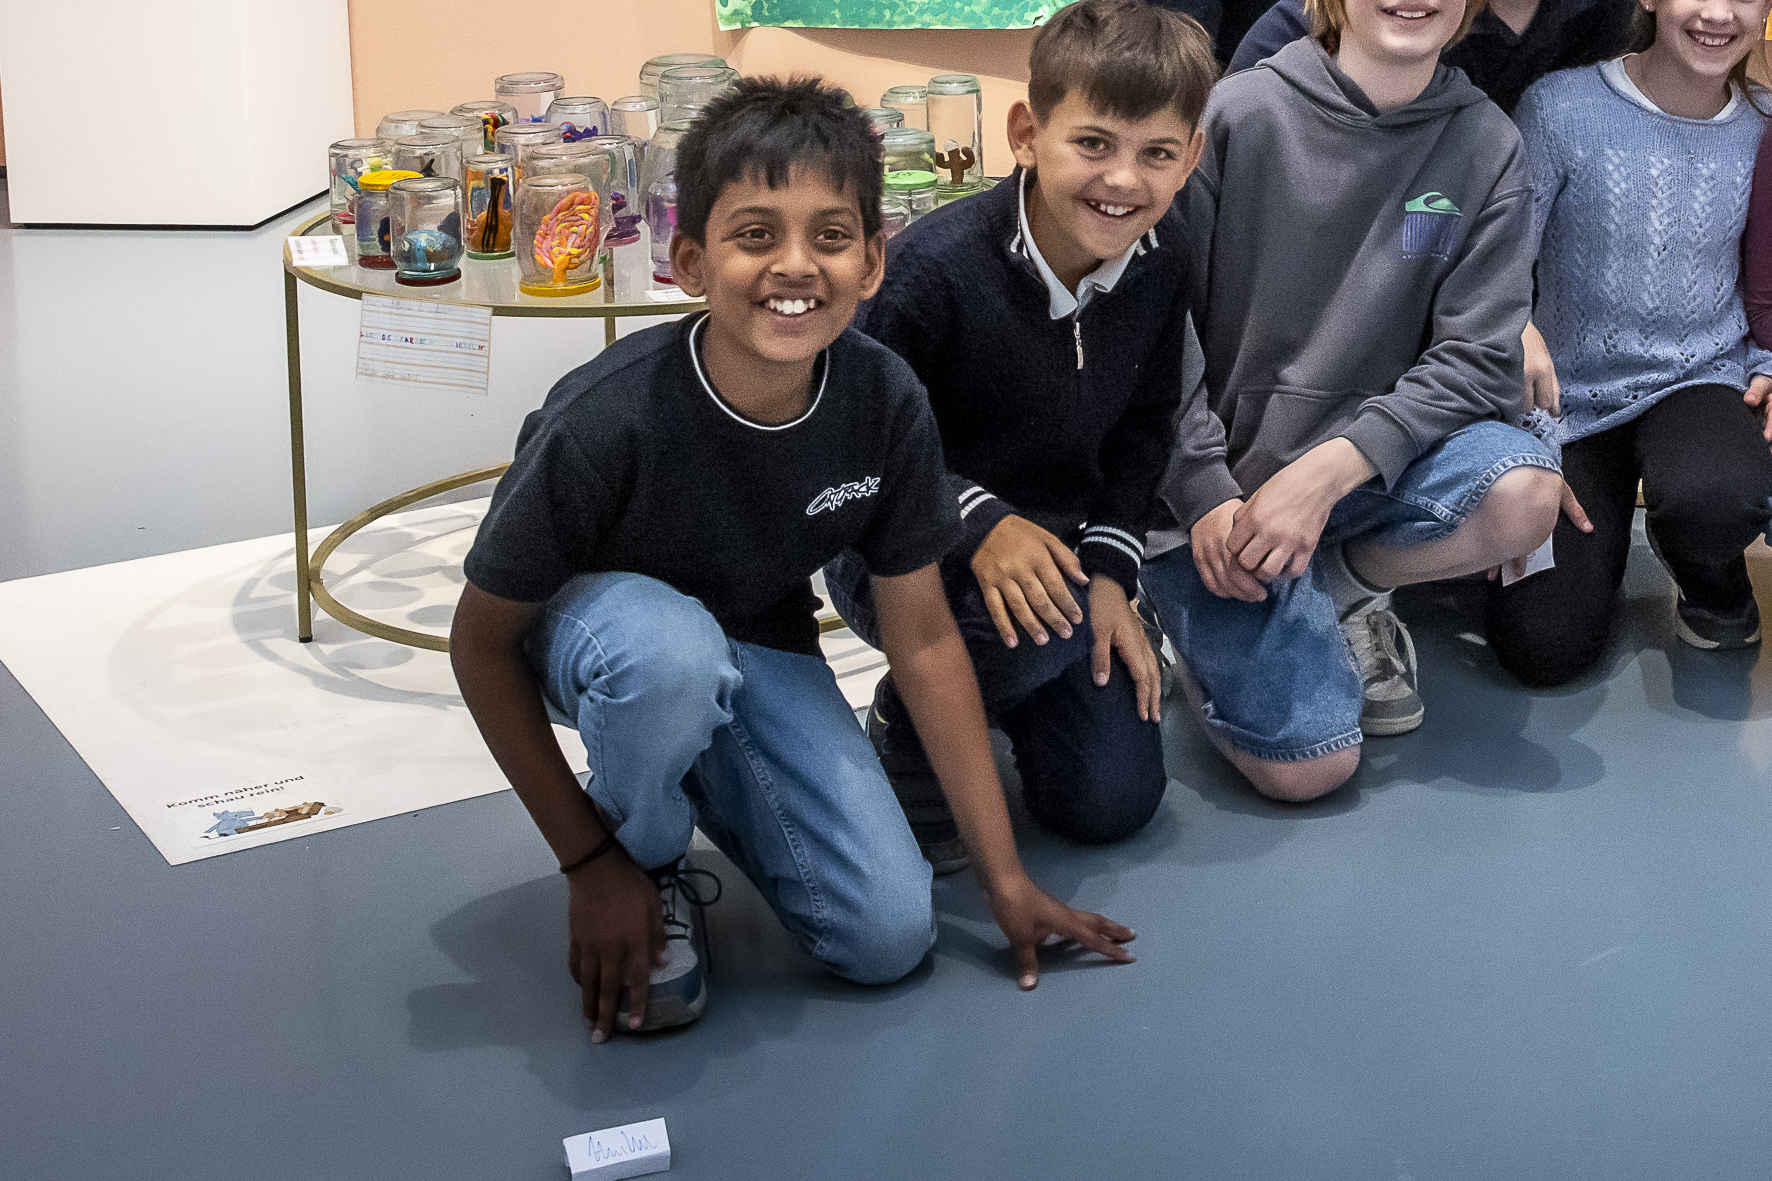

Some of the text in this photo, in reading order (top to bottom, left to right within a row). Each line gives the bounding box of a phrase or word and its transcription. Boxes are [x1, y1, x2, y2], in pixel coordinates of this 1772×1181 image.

[166, 775, 305, 809] Komm näher und
[197, 786, 285, 808] schau rein!
